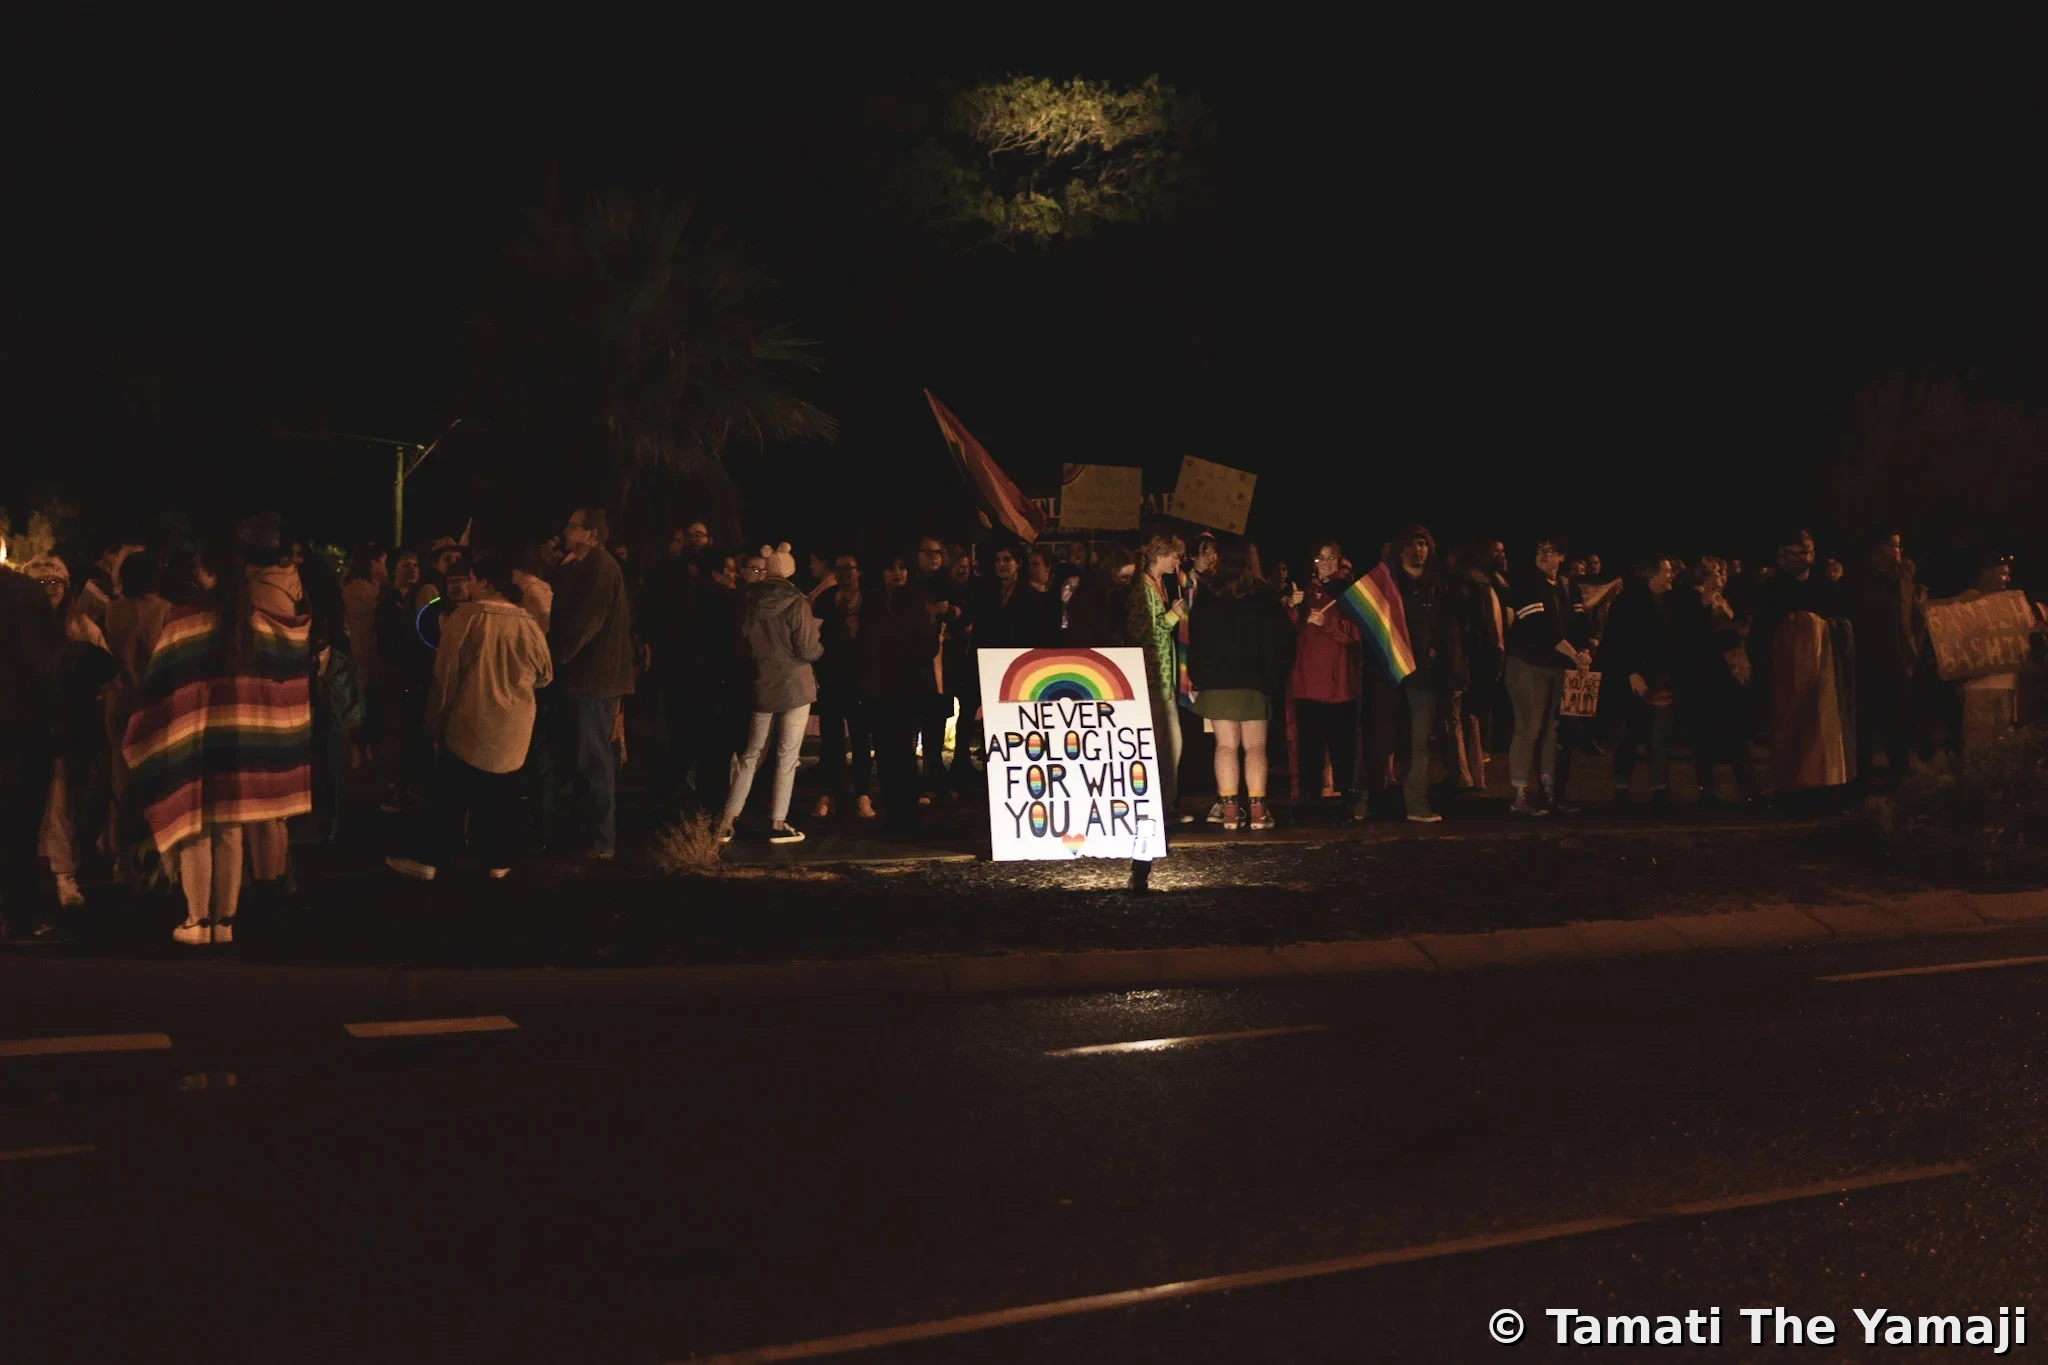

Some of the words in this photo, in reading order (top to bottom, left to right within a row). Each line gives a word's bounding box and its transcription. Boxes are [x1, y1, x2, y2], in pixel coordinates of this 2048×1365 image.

[1018, 702, 1117, 730] NEVER
[987, 727, 1153, 763] APOLOGISE
[1006, 763, 1071, 799] FOR
[1079, 760, 1148, 797] WHO
[1005, 800, 1070, 838] YOU
